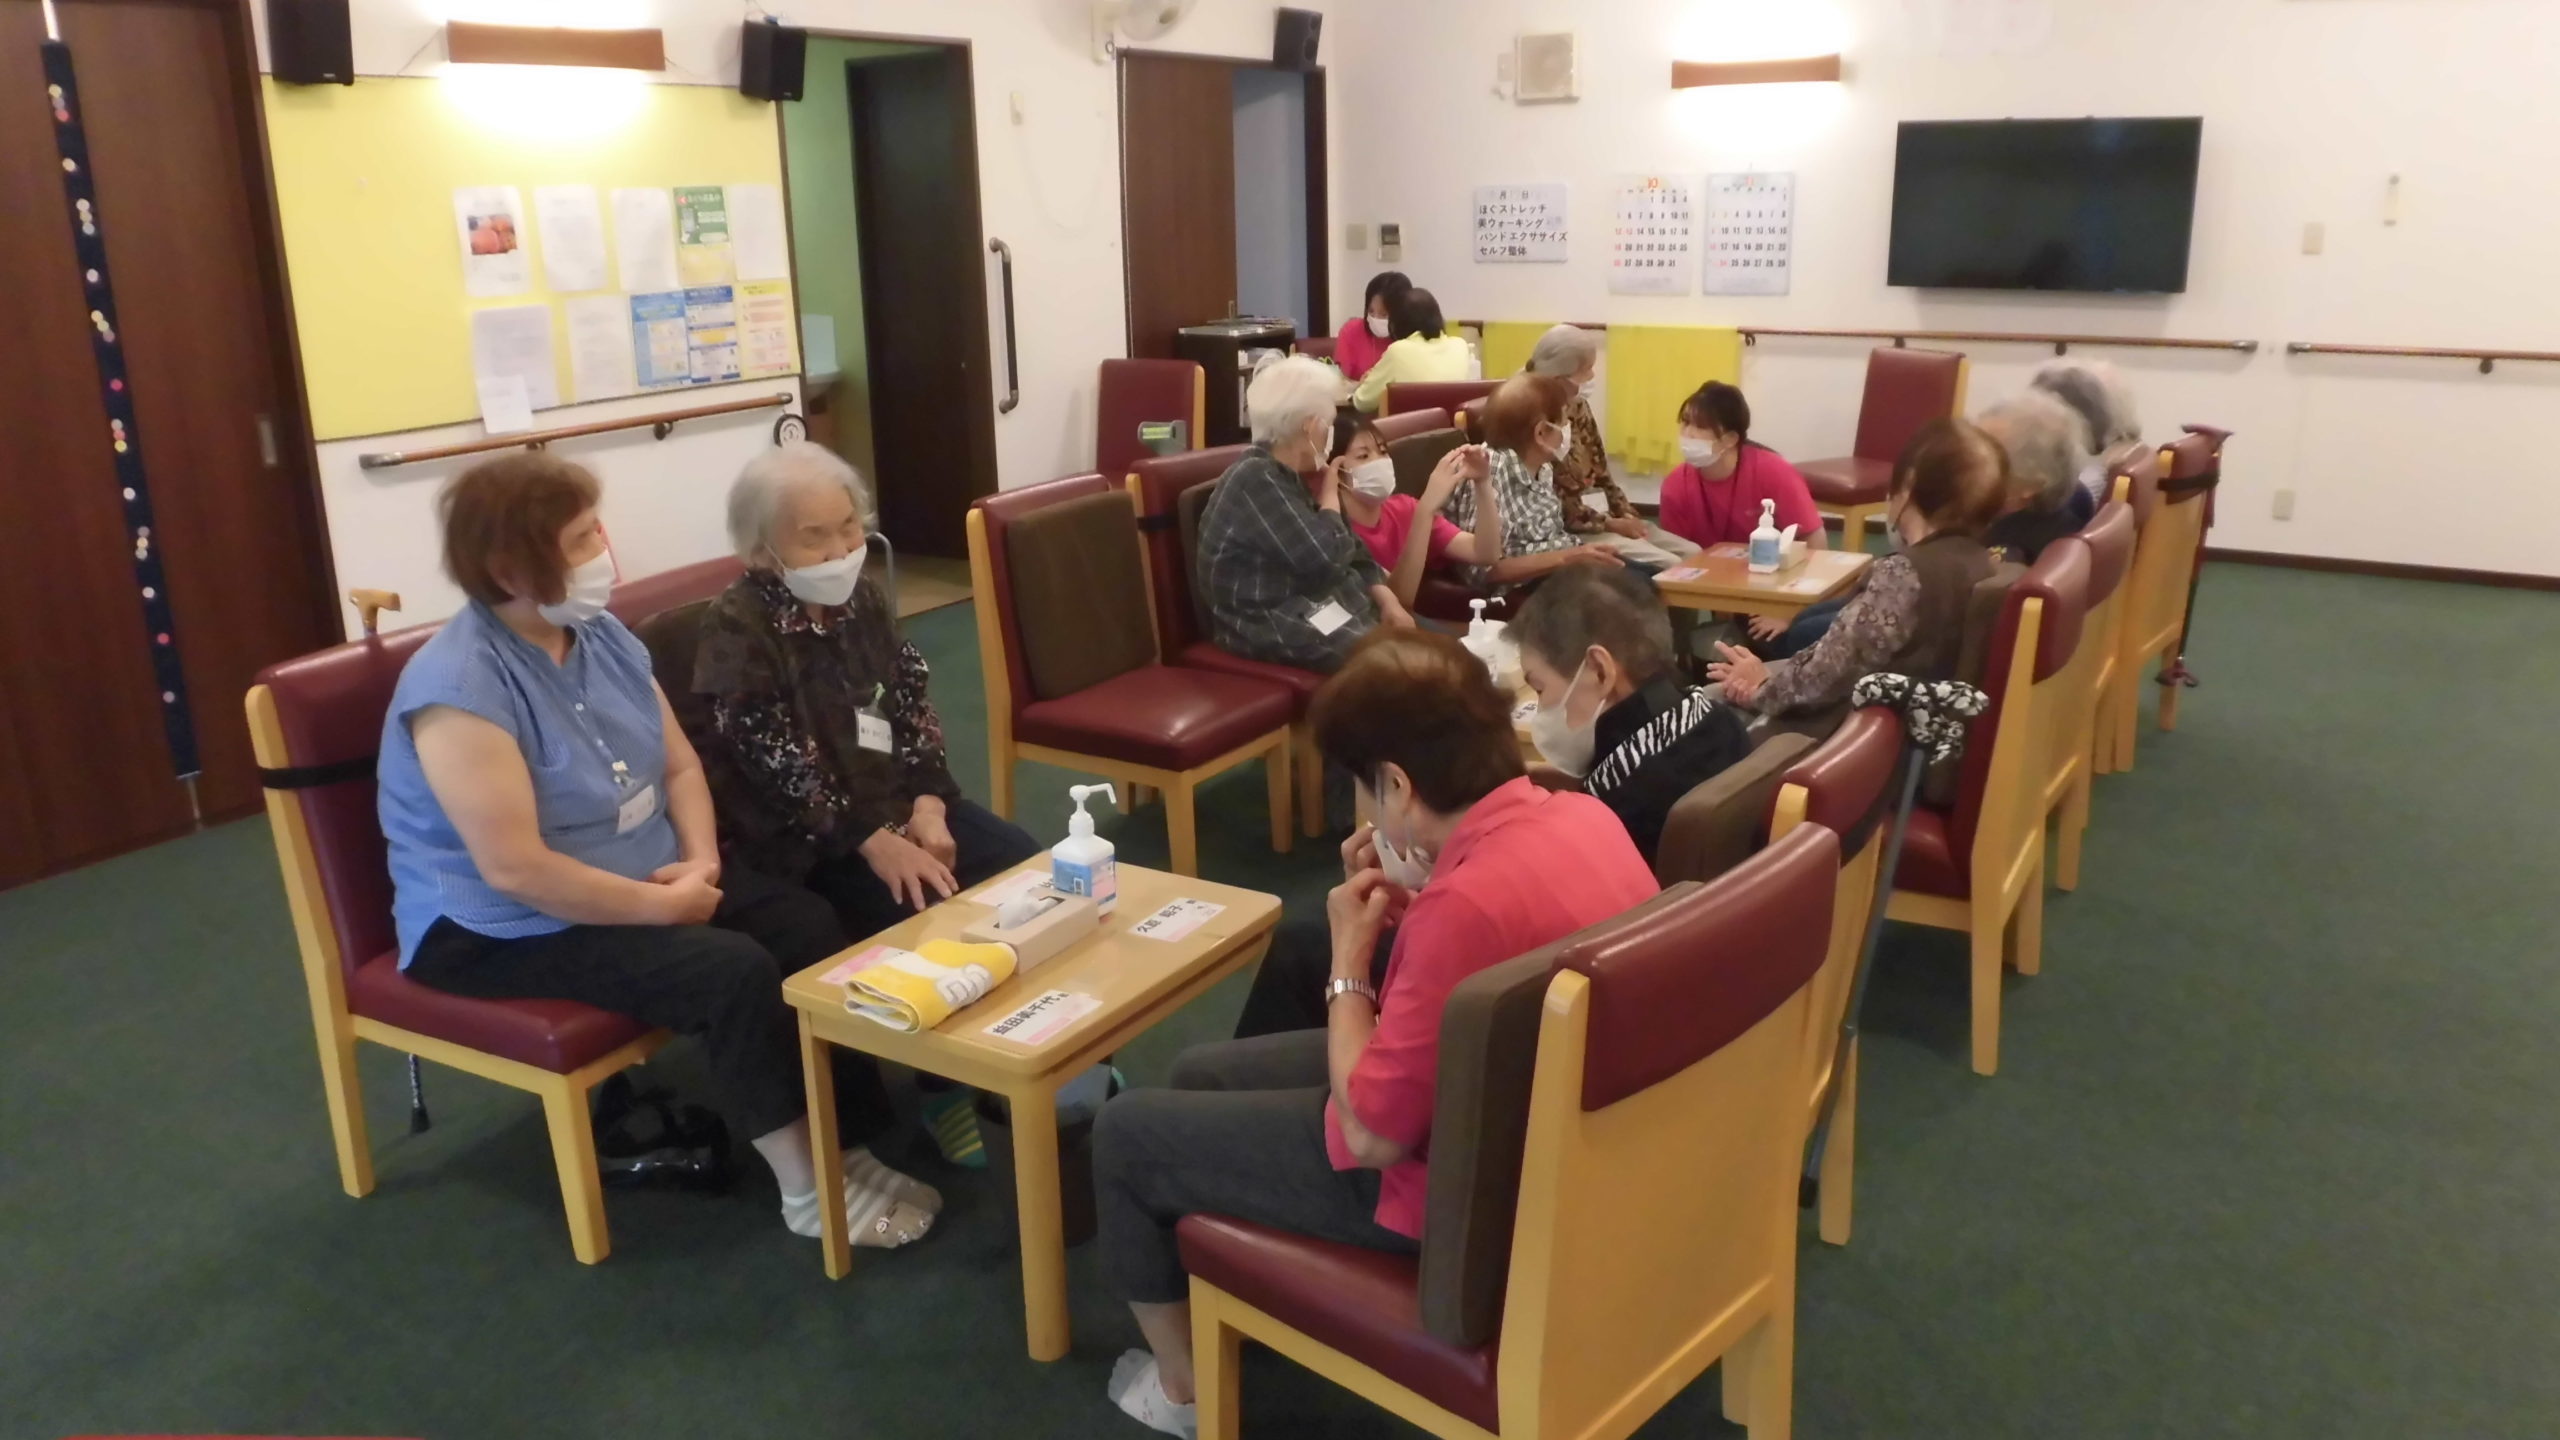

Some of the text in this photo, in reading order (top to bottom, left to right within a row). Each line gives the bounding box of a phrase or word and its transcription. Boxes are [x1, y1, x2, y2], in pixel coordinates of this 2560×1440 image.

[1648, 177, 1658, 188] 10
[1500, 191, 1528, 199] 月 日
[1480, 204, 1547, 214] ほぐストレッチ
[1480, 246, 1527, 256] セルフ整体
[1755, 243, 1763, 251] 20
